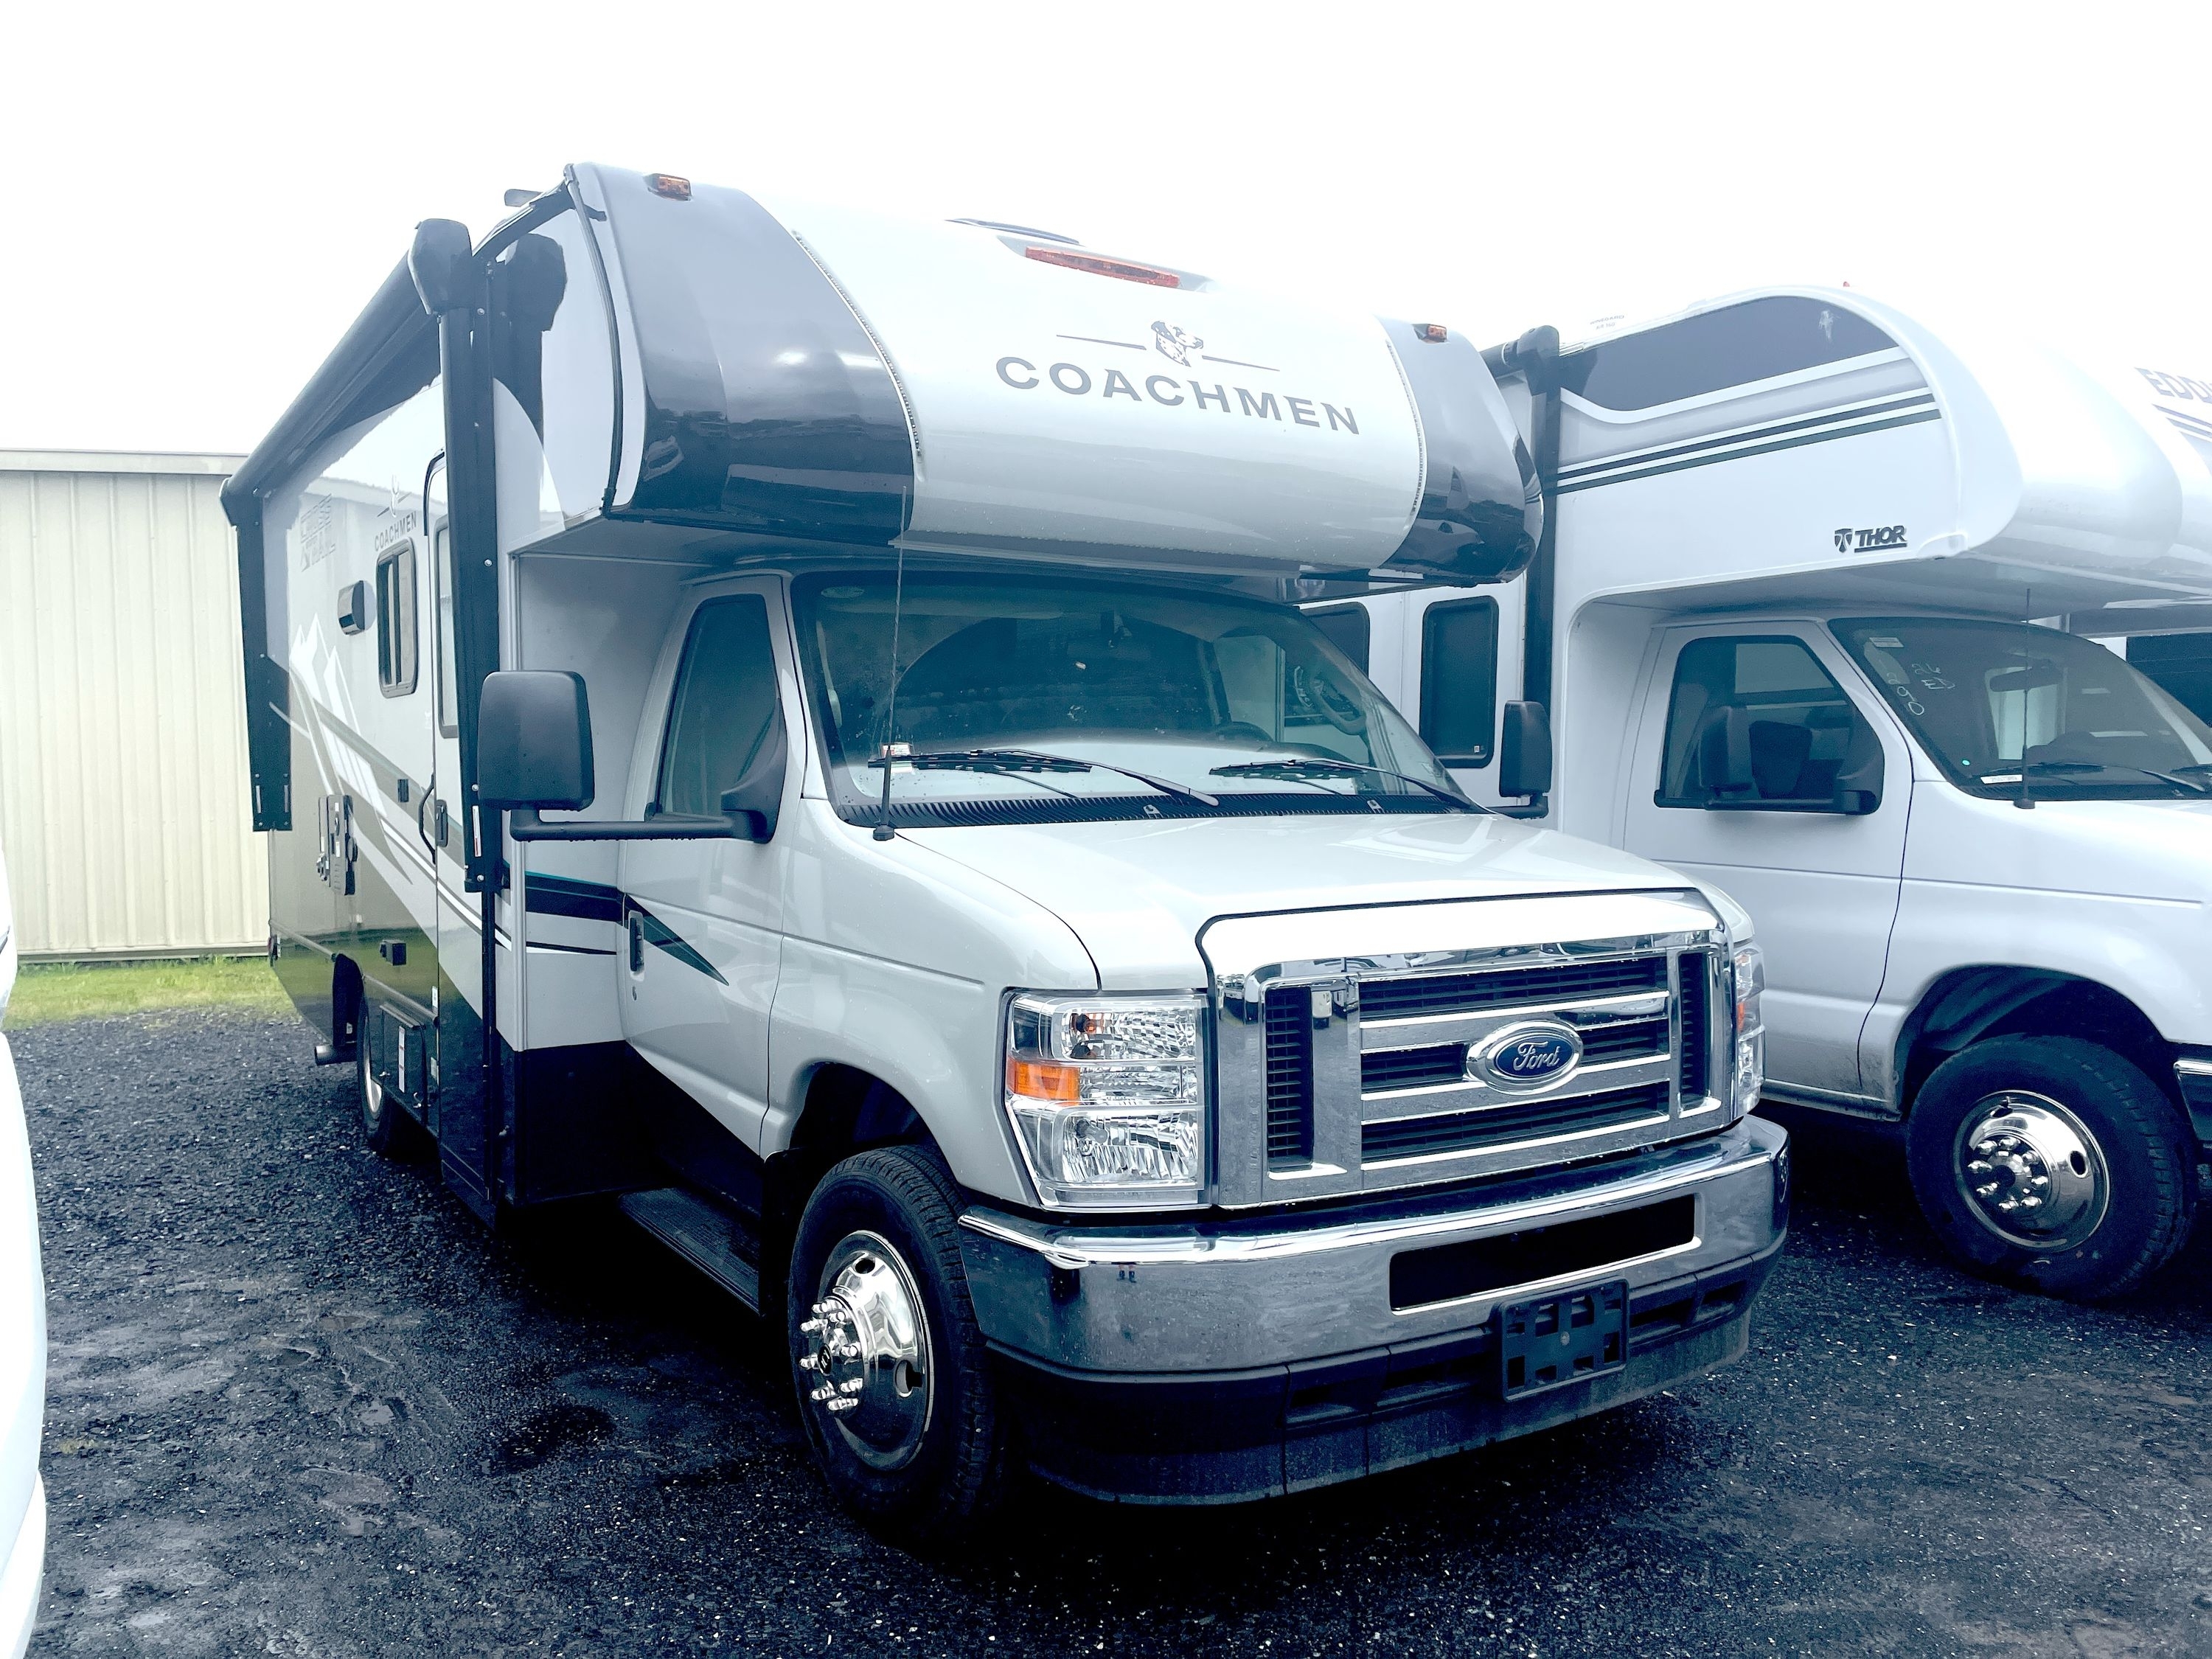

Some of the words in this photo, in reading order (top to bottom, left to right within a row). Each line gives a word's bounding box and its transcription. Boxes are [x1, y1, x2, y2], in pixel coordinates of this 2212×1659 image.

[995, 356, 1360, 435] COACHMEN
[374, 510, 417, 552] COACHMEN
[1854, 524, 1908, 547] THOR
[1513, 1040, 1561, 1071] Ford
